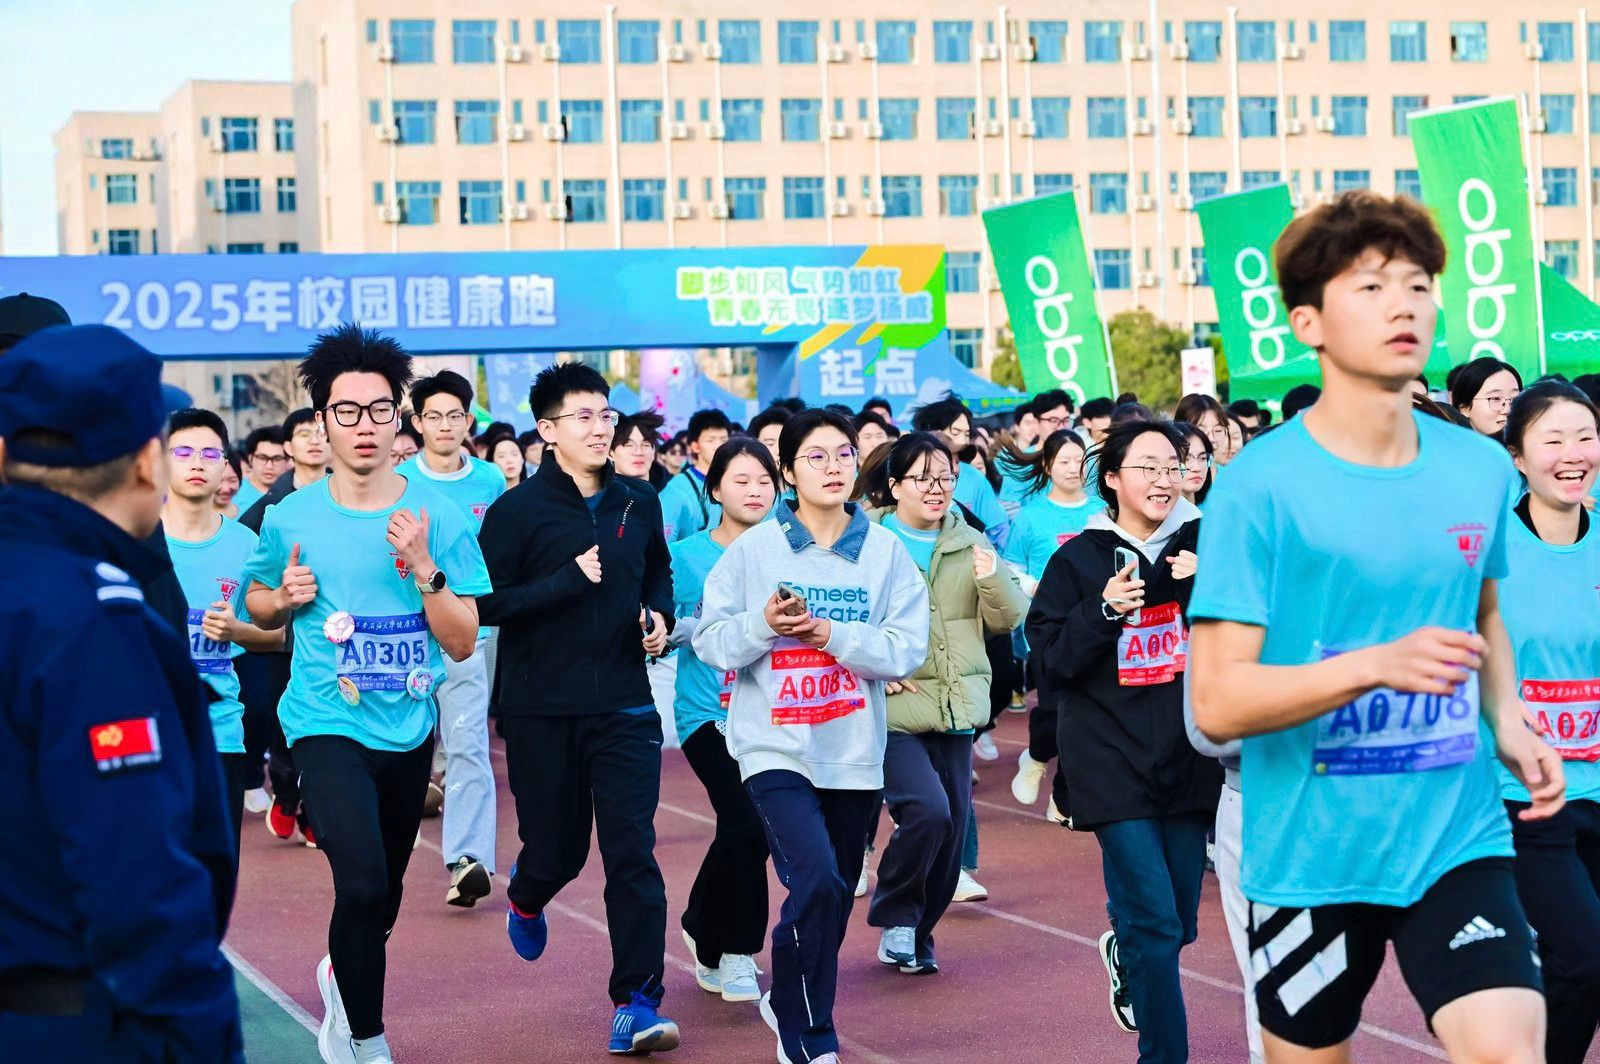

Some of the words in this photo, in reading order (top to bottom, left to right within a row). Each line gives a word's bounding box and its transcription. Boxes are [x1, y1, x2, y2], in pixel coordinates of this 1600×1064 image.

[679, 269, 787, 297] 脚步如风
[794, 269, 899, 295] 气势如虹
[101, 273, 557, 332] 2025年校园健康跑
[819, 348, 917, 396] 起点
[808, 587, 868, 603] meet
[341, 639, 425, 666] A0305
[778, 669, 857, 701] A0083
[1328, 681, 1470, 736] A0708
